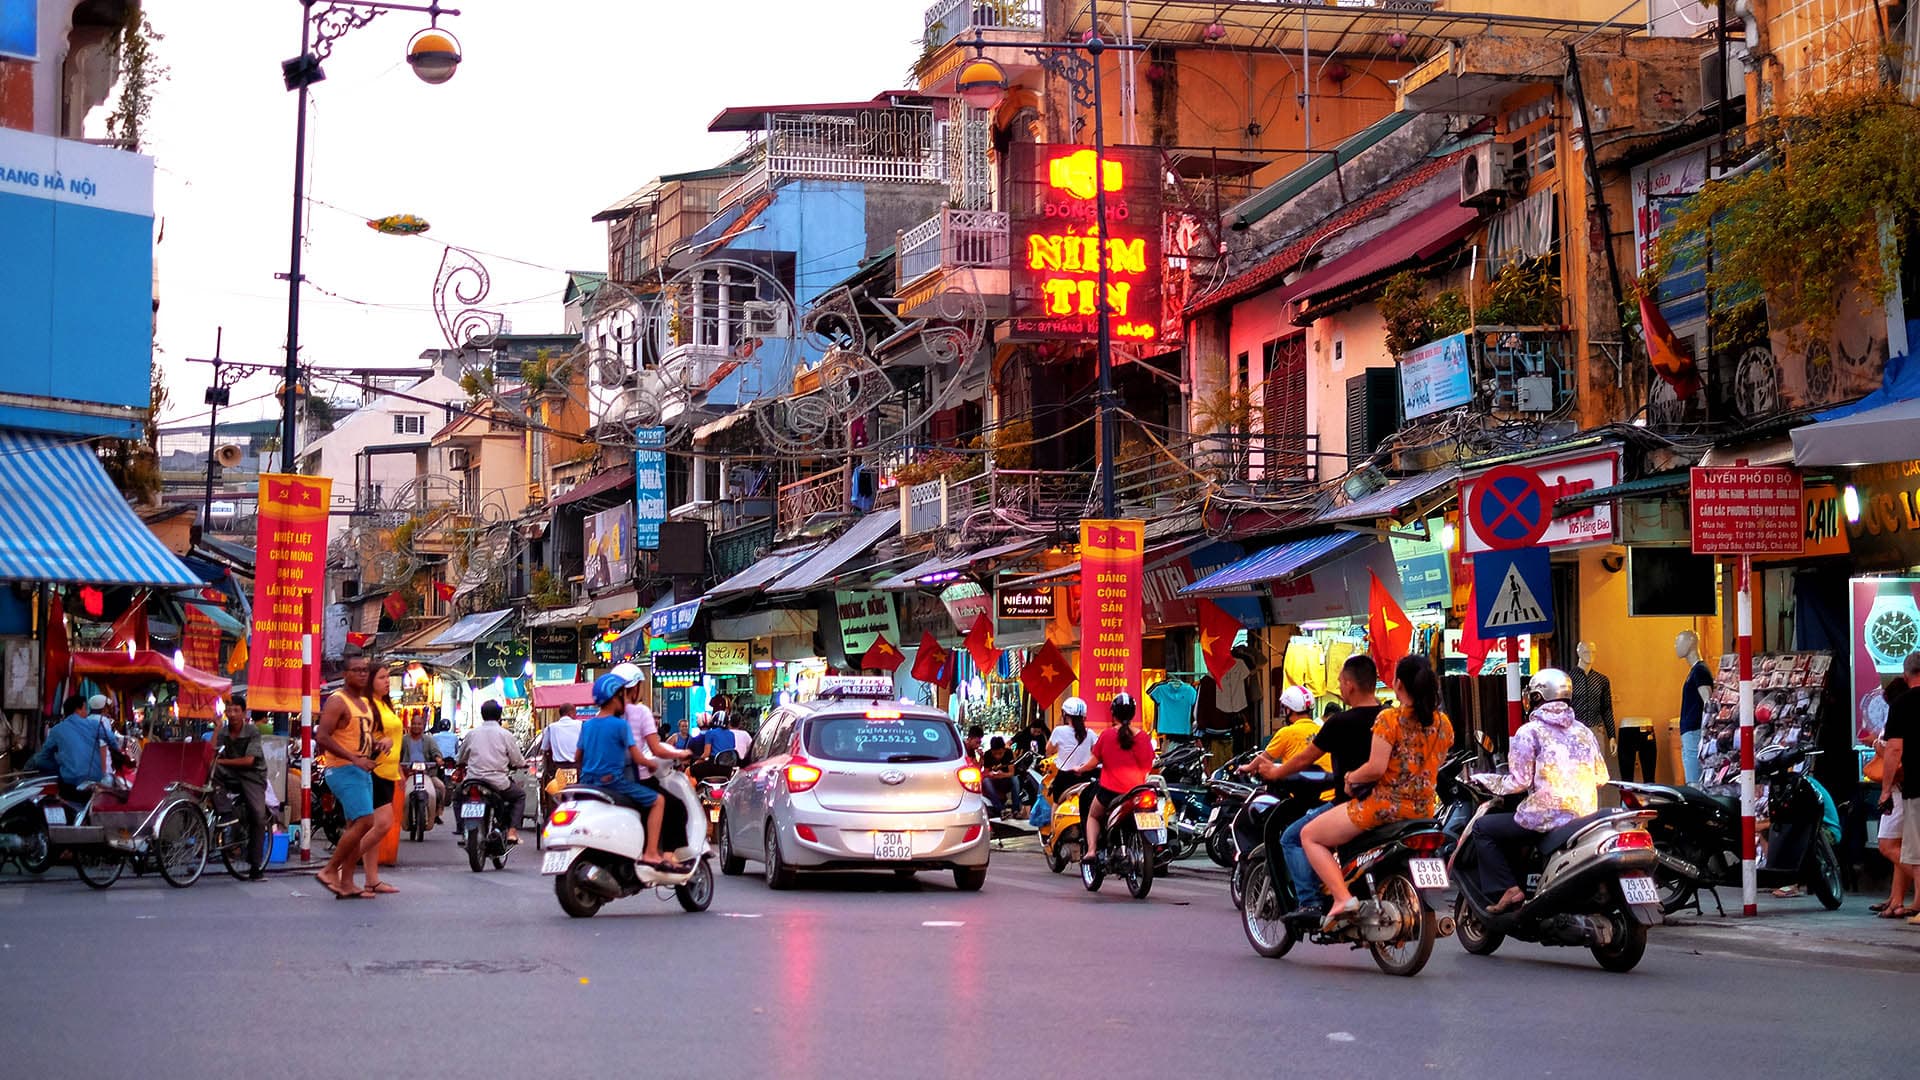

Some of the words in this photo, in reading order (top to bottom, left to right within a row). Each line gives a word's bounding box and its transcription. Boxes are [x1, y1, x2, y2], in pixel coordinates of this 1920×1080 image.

[44, 170, 65, 190] HÀ
[70, 177, 96, 200] NỘI
[1041, 279, 1131, 316] TIN
[639, 450, 662, 463] HOUSE
[1740, 471, 1762, 483] PHỐ
[1764, 474, 1774, 483] ĐI
[1777, 472, 1792, 486] BỘ
[1714, 503, 1726, 516] CÁC
[274, 531, 294, 543] NHIỆT
[295, 531, 312, 546] LIỆT
[270, 549, 289, 561] CHÀO
[290, 567, 303, 579] HỘI
[1096, 570, 1127, 583] ĐẢNG
[266, 583, 281, 596] LẦN
[1096, 587, 1127, 599] CỘNG
[1034, 596, 1052, 605] TIN
[1100, 600, 1123, 613] SẢN
[255, 619, 277, 633] QUẬN
[1100, 617, 1123, 629] VIỆT
[1099, 633, 1124, 642] NAM
[268, 638, 292, 651] NHIỆM
[732, 648, 746, 659] 15
[1093, 648, 1130, 658] QUANG
[1099, 663, 1124, 673] VINH
[1095, 676, 1127, 687] MUÔN
[670, 691, 682, 701] 79
[855, 735, 917, 744] 62.52.52.52
[883, 833, 903, 845] 30A
[876, 846, 910, 858] 485.02
